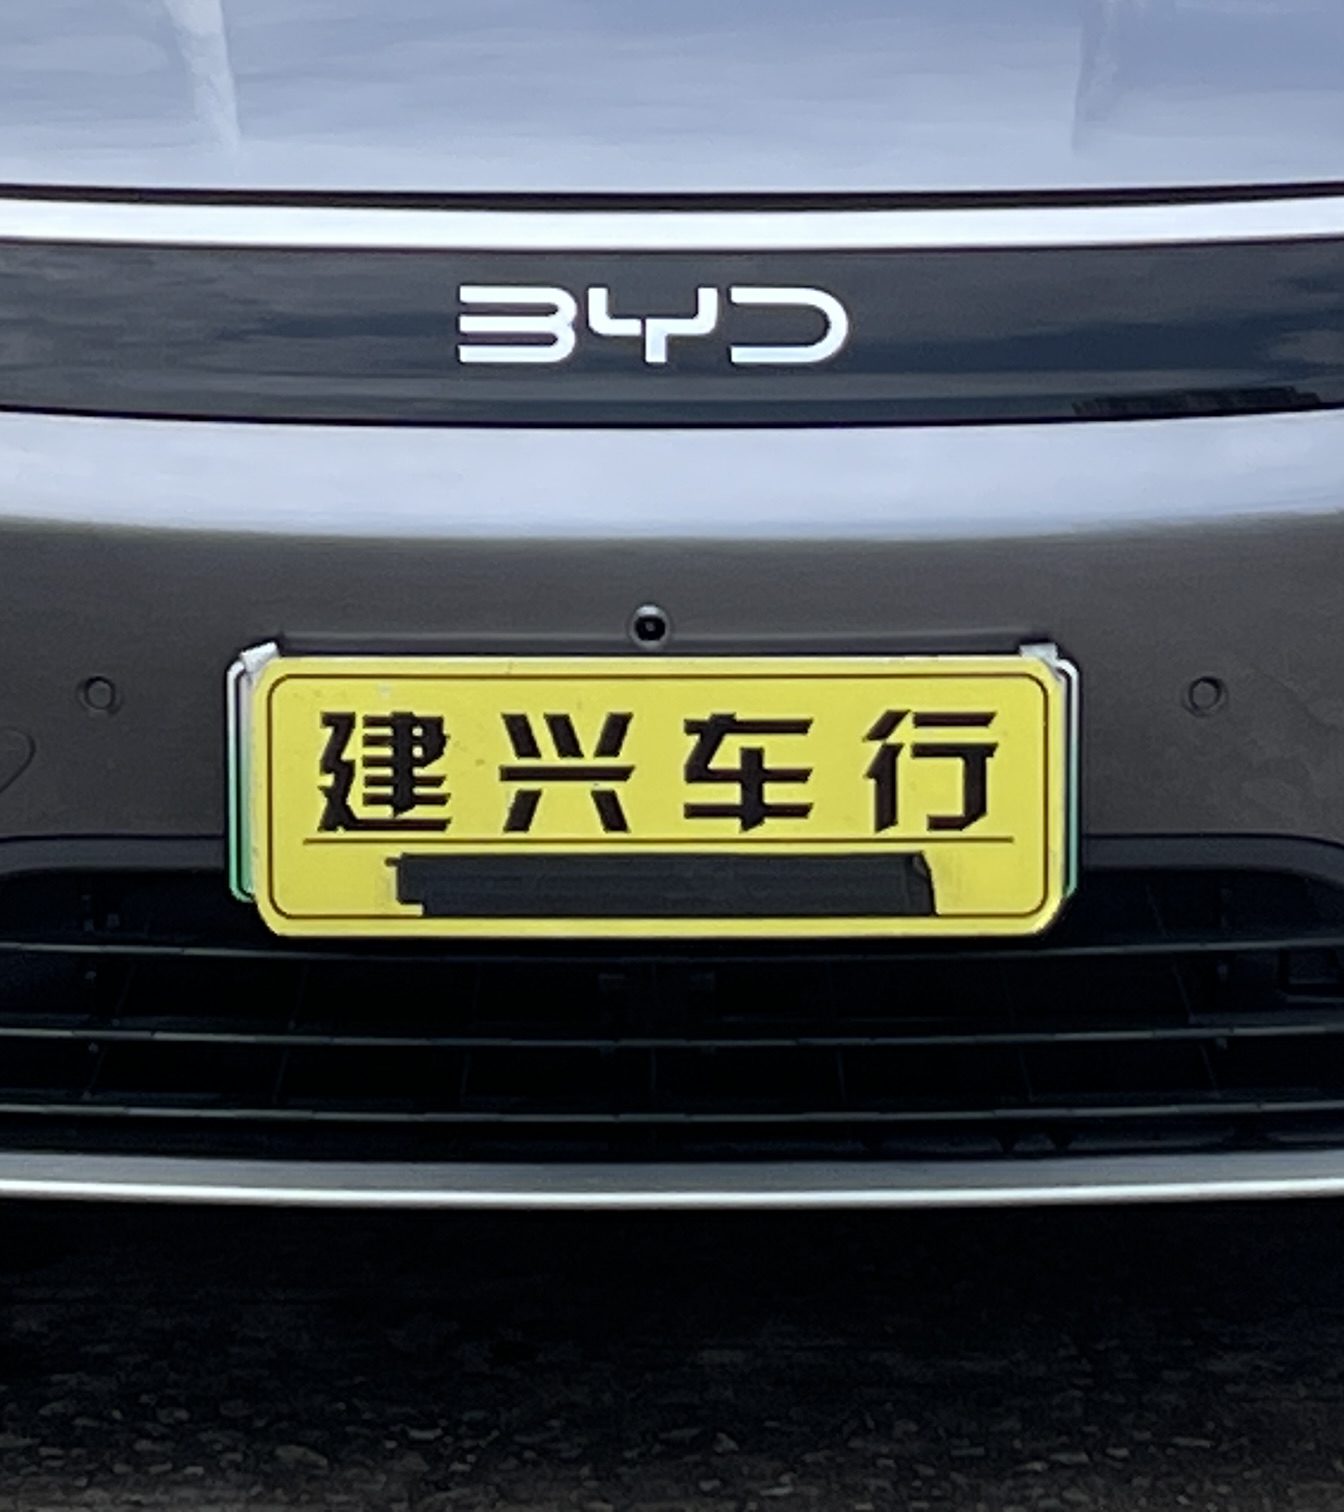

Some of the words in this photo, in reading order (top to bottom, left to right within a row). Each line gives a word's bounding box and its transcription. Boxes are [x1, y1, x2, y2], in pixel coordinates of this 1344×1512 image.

[459, 285, 850, 364] BYD
[316, 708, 1000, 834] 建兴车行
